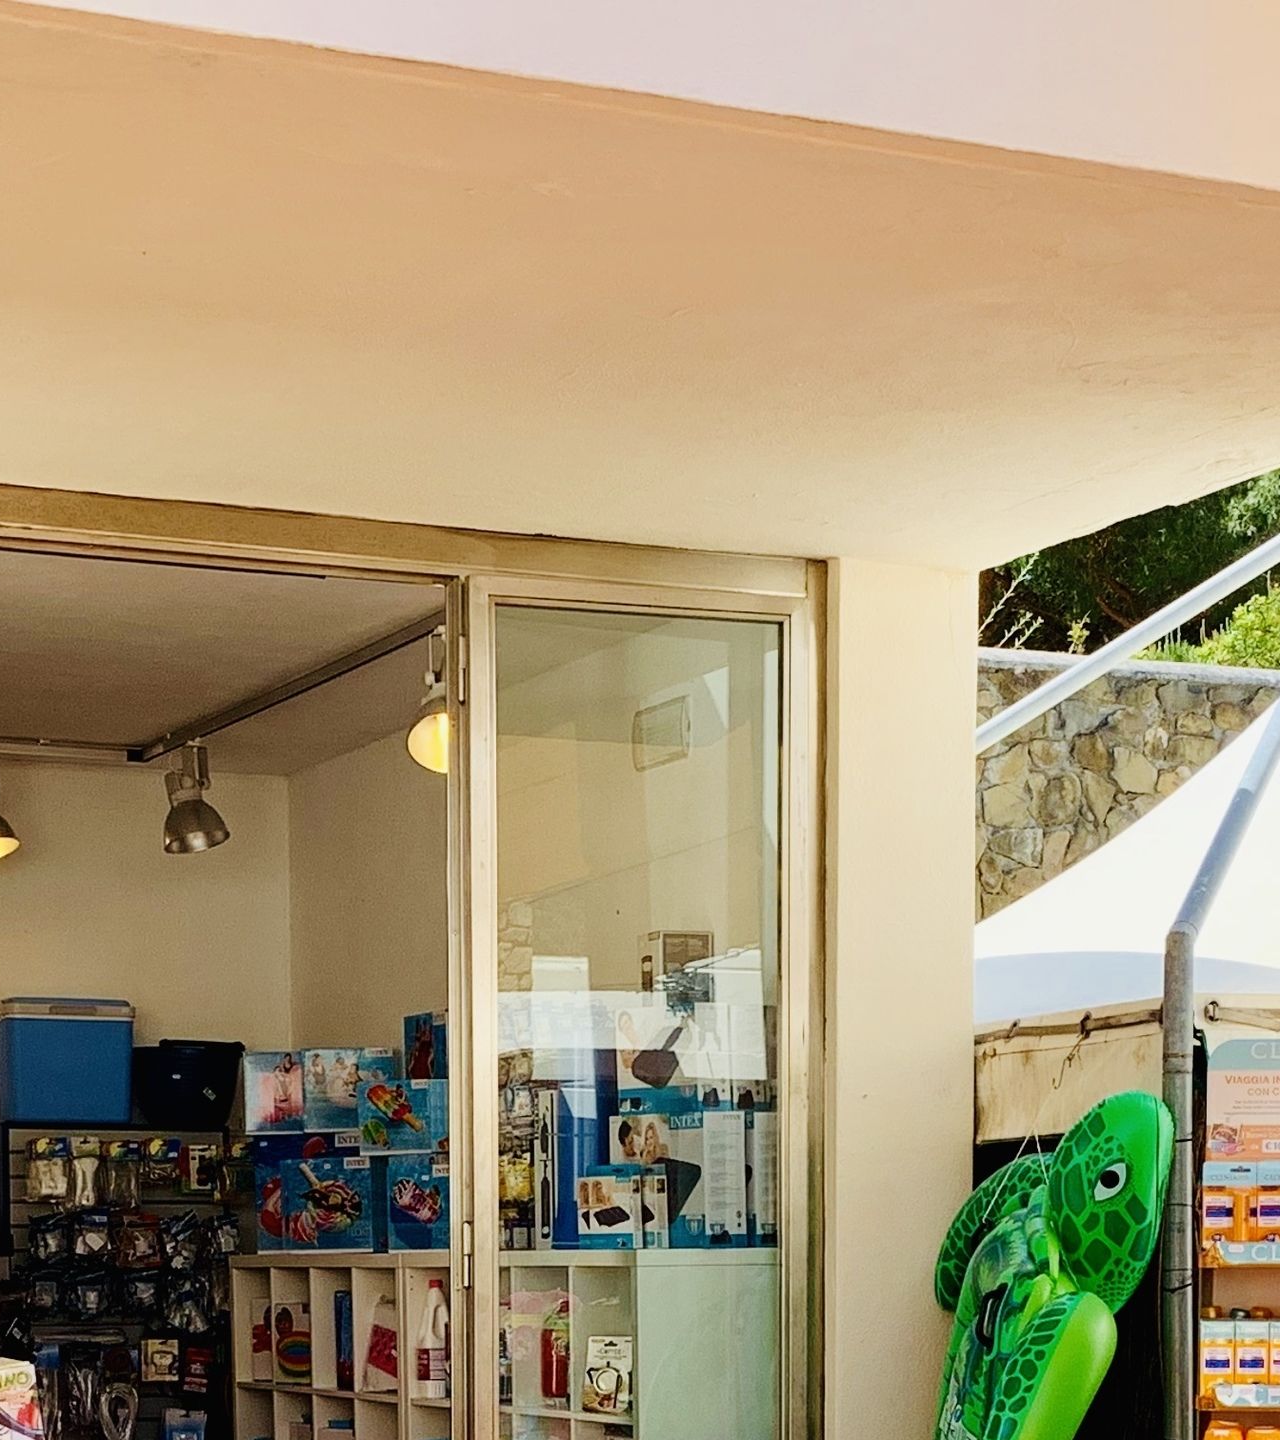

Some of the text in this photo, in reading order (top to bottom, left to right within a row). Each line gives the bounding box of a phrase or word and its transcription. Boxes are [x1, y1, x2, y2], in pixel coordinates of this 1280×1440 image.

[1225, 1075, 1269, 1085] VIAGGIA
[1247, 1088, 1270, 1097] CON
[671, 1115, 701, 1129] INTEX
